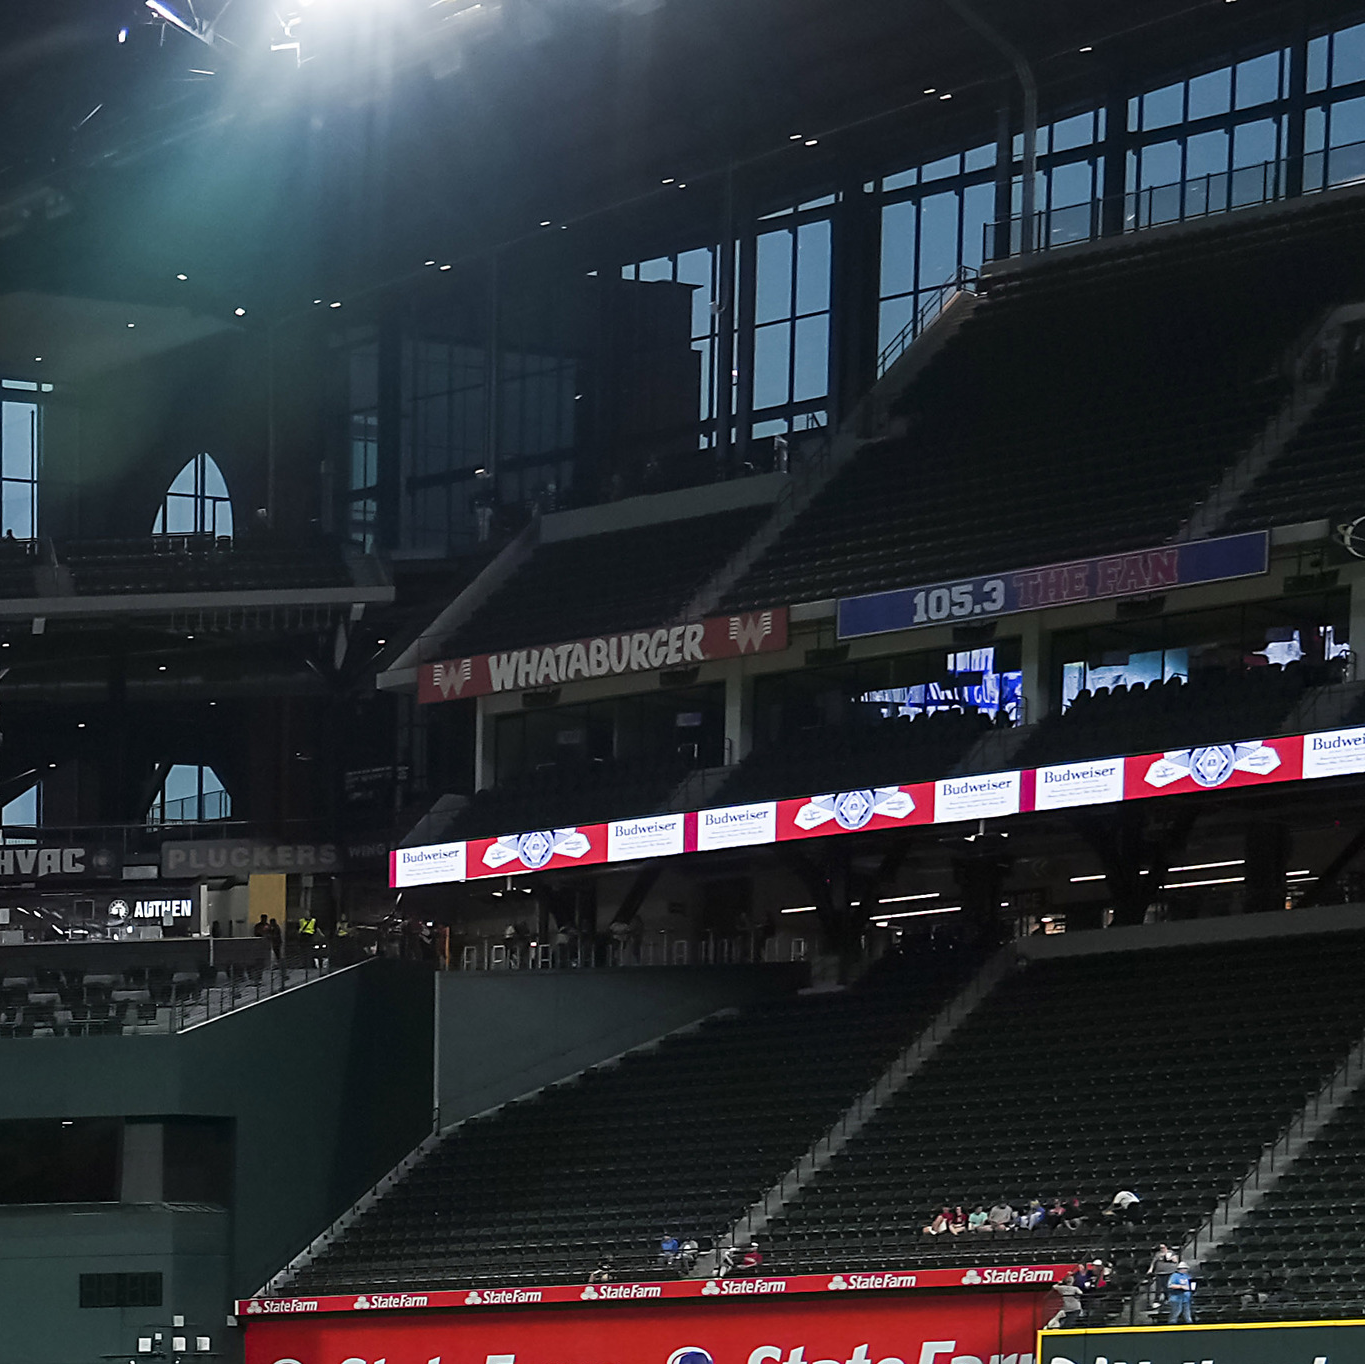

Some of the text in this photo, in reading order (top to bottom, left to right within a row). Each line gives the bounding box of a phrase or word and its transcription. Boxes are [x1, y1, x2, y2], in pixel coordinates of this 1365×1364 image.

[912, 549, 1179, 624] 105.3 THE FAN
[488, 624, 704, 691] WHATABURGER
[1044, 765, 1116, 783] Budweiser
[942, 778, 1012, 796] Budweiser
[705, 808, 769, 826] Budweiser
[615, 820, 677, 837] Budweiser
[169, 844, 337, 869] PLUCKERS
[402, 848, 460, 864] Budweiser
